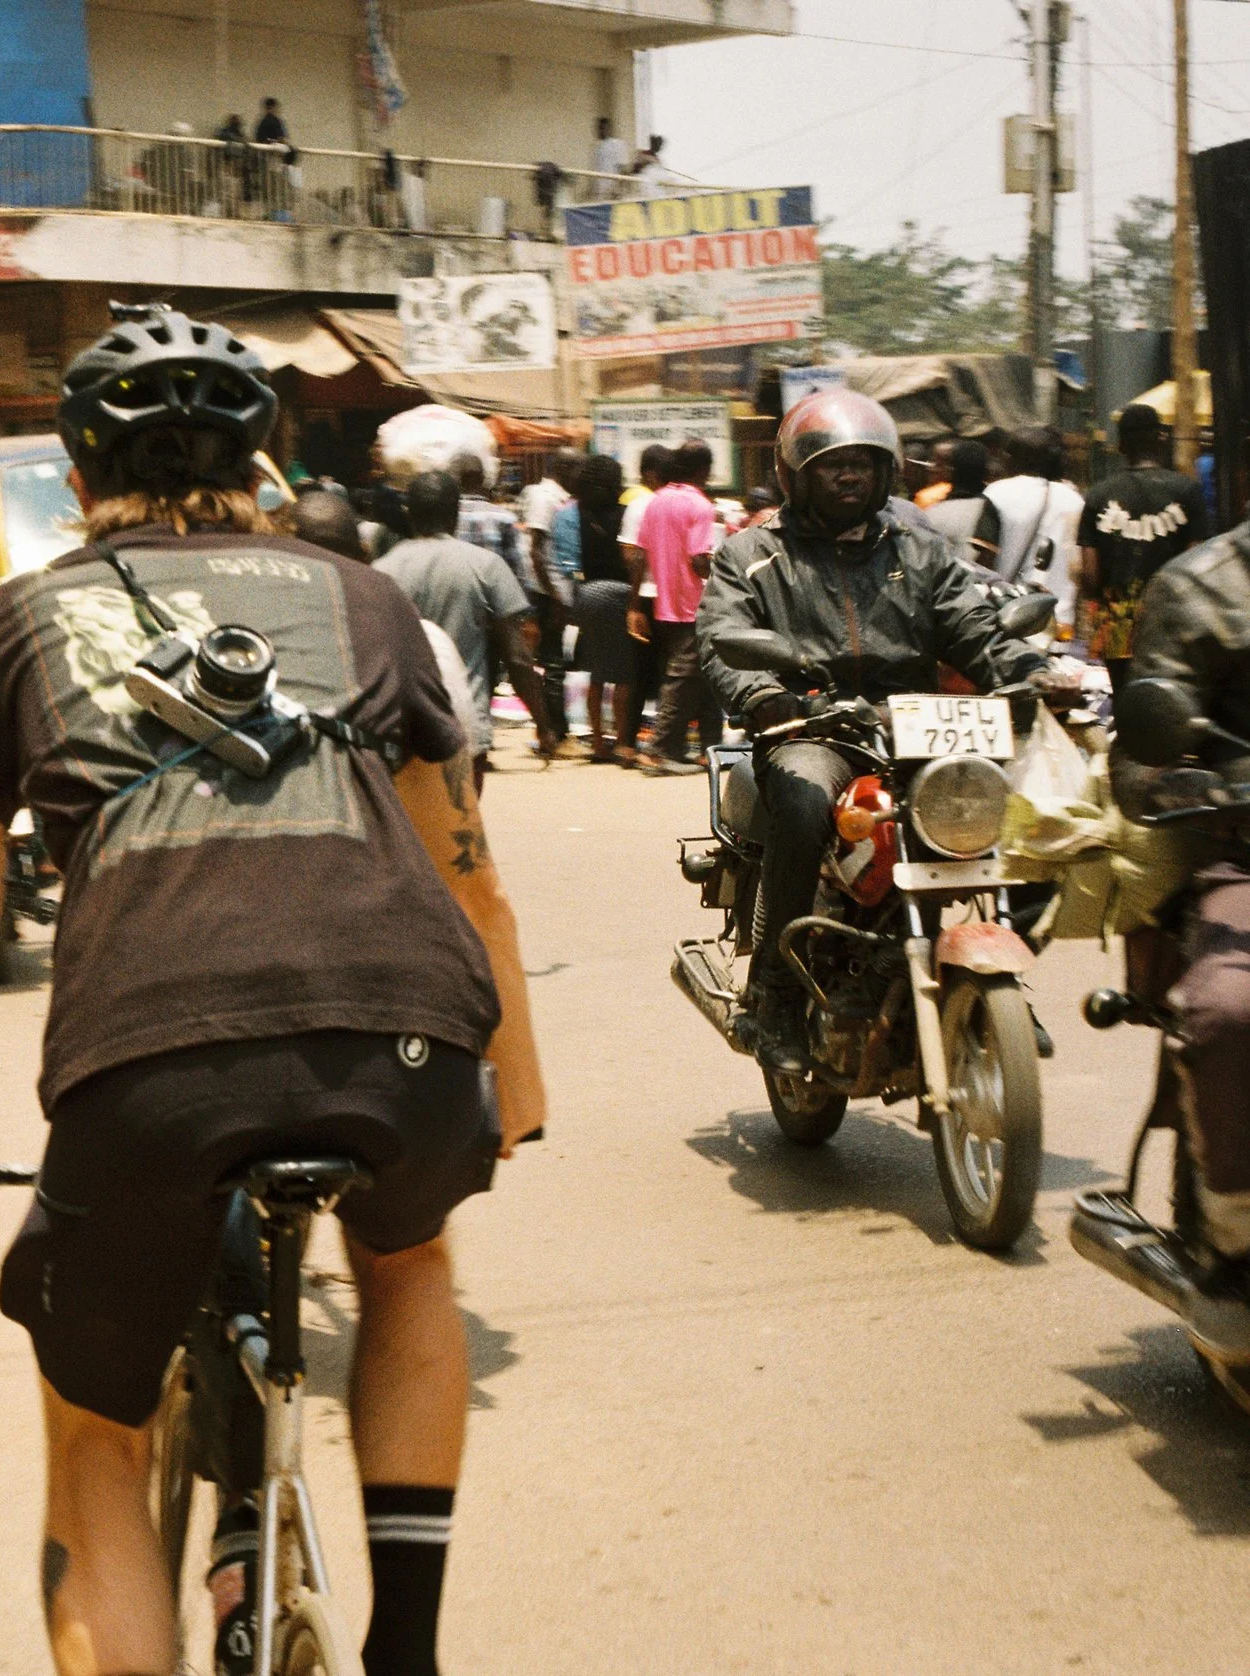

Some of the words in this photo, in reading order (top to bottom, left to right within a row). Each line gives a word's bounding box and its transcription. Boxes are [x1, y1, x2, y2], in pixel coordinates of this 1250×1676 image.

[609, 189, 787, 242] ADULT
[570, 226, 820, 283] EDUCATION
[936, 700, 994, 724] UFL
[925, 728, 998, 753] 791Y
